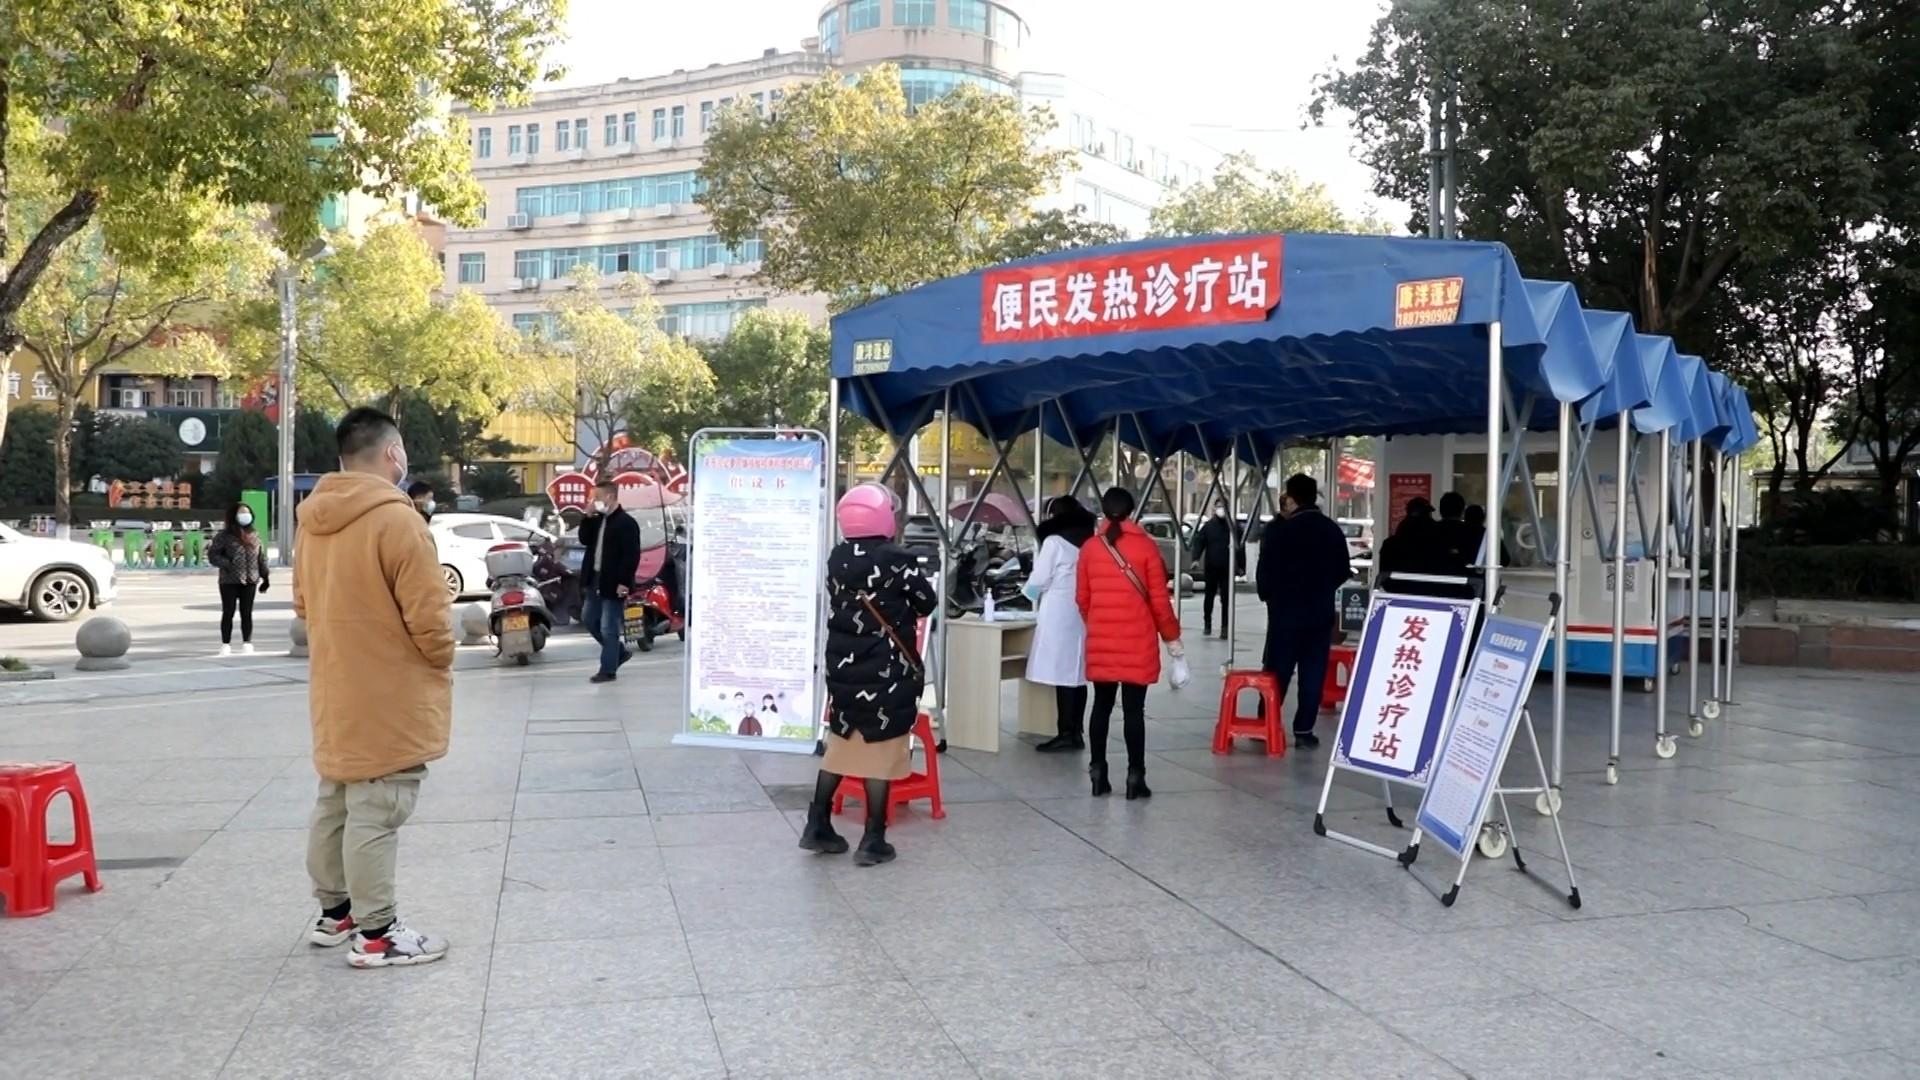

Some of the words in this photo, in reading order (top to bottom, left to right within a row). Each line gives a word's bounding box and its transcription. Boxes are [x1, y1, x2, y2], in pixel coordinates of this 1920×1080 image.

[992, 255, 1269, 332] 便民发热诊疗站
[1369, 615, 1430, 760] 发热诊疗站
